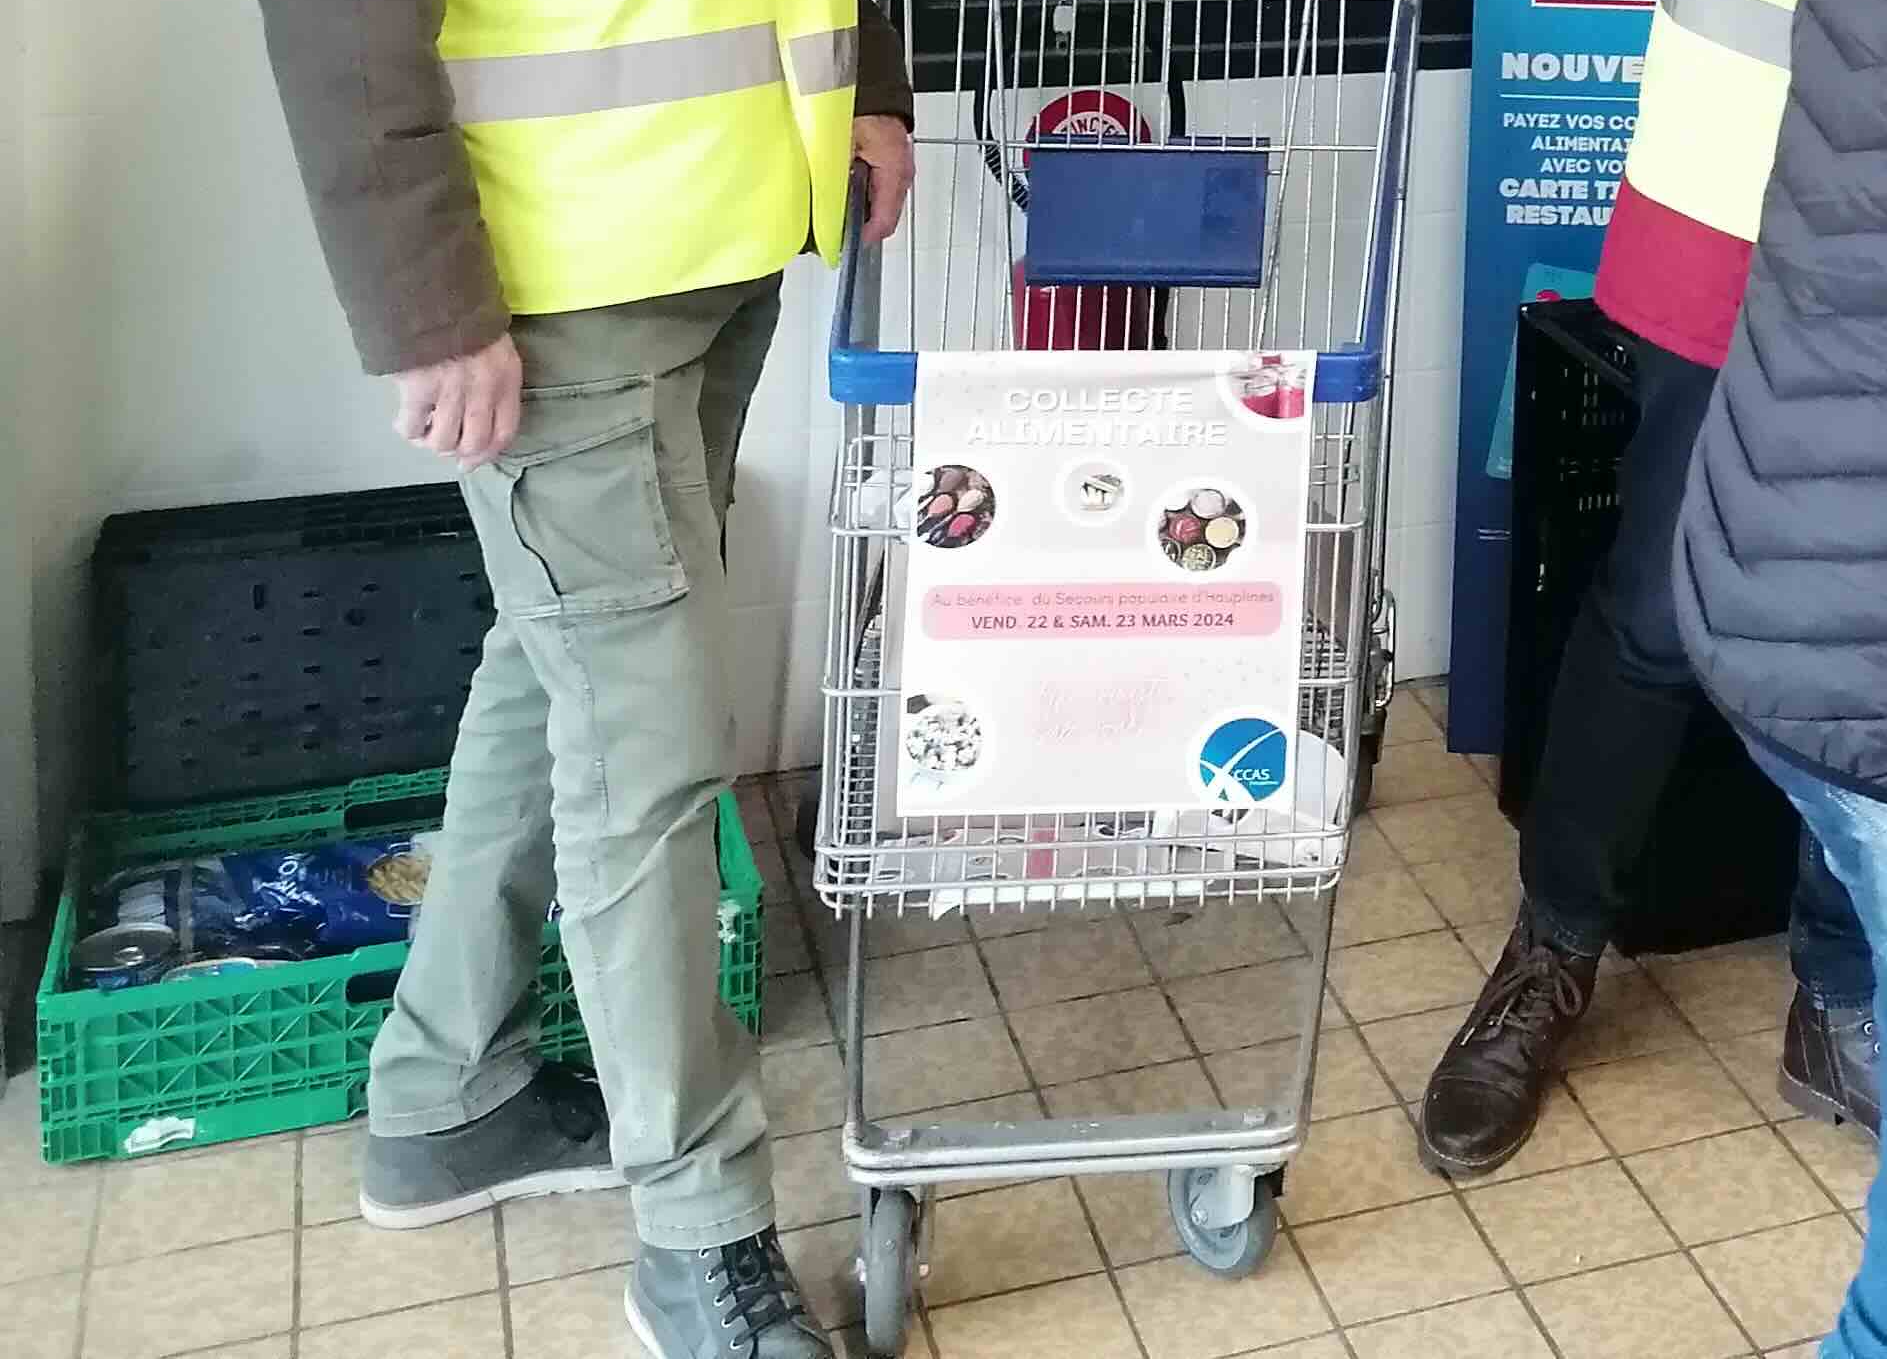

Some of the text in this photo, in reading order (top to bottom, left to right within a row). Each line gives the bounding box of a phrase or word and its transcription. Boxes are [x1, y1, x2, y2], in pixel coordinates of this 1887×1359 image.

[1502, 53, 1645, 83] NOUVE
[1503, 112, 1637, 131] PAYEZ VOS CO
[1530, 135, 1633, 153] ALIMENTAI
[1540, 157, 1626, 174] AVEC VO
[1499, 177, 1589, 200] CARTE
[1505, 203, 1615, 226] RESTAU
[1005, 387, 1194, 416] COLLECTE
[966, 419, 1228, 449] ALIMENTAIRE
[1032, 592, 1050, 606] du
[1027, 615, 1048, 629] 22
[1053, 616, 1065, 628] &
[1070, 615, 1111, 628] SAM.
[1116, 614, 1136, 627] 23
[1141, 613, 1188, 627] MARS
[1193, 613, 1234, 627] 2024
[1234, 768, 1270, 781] CCAS
